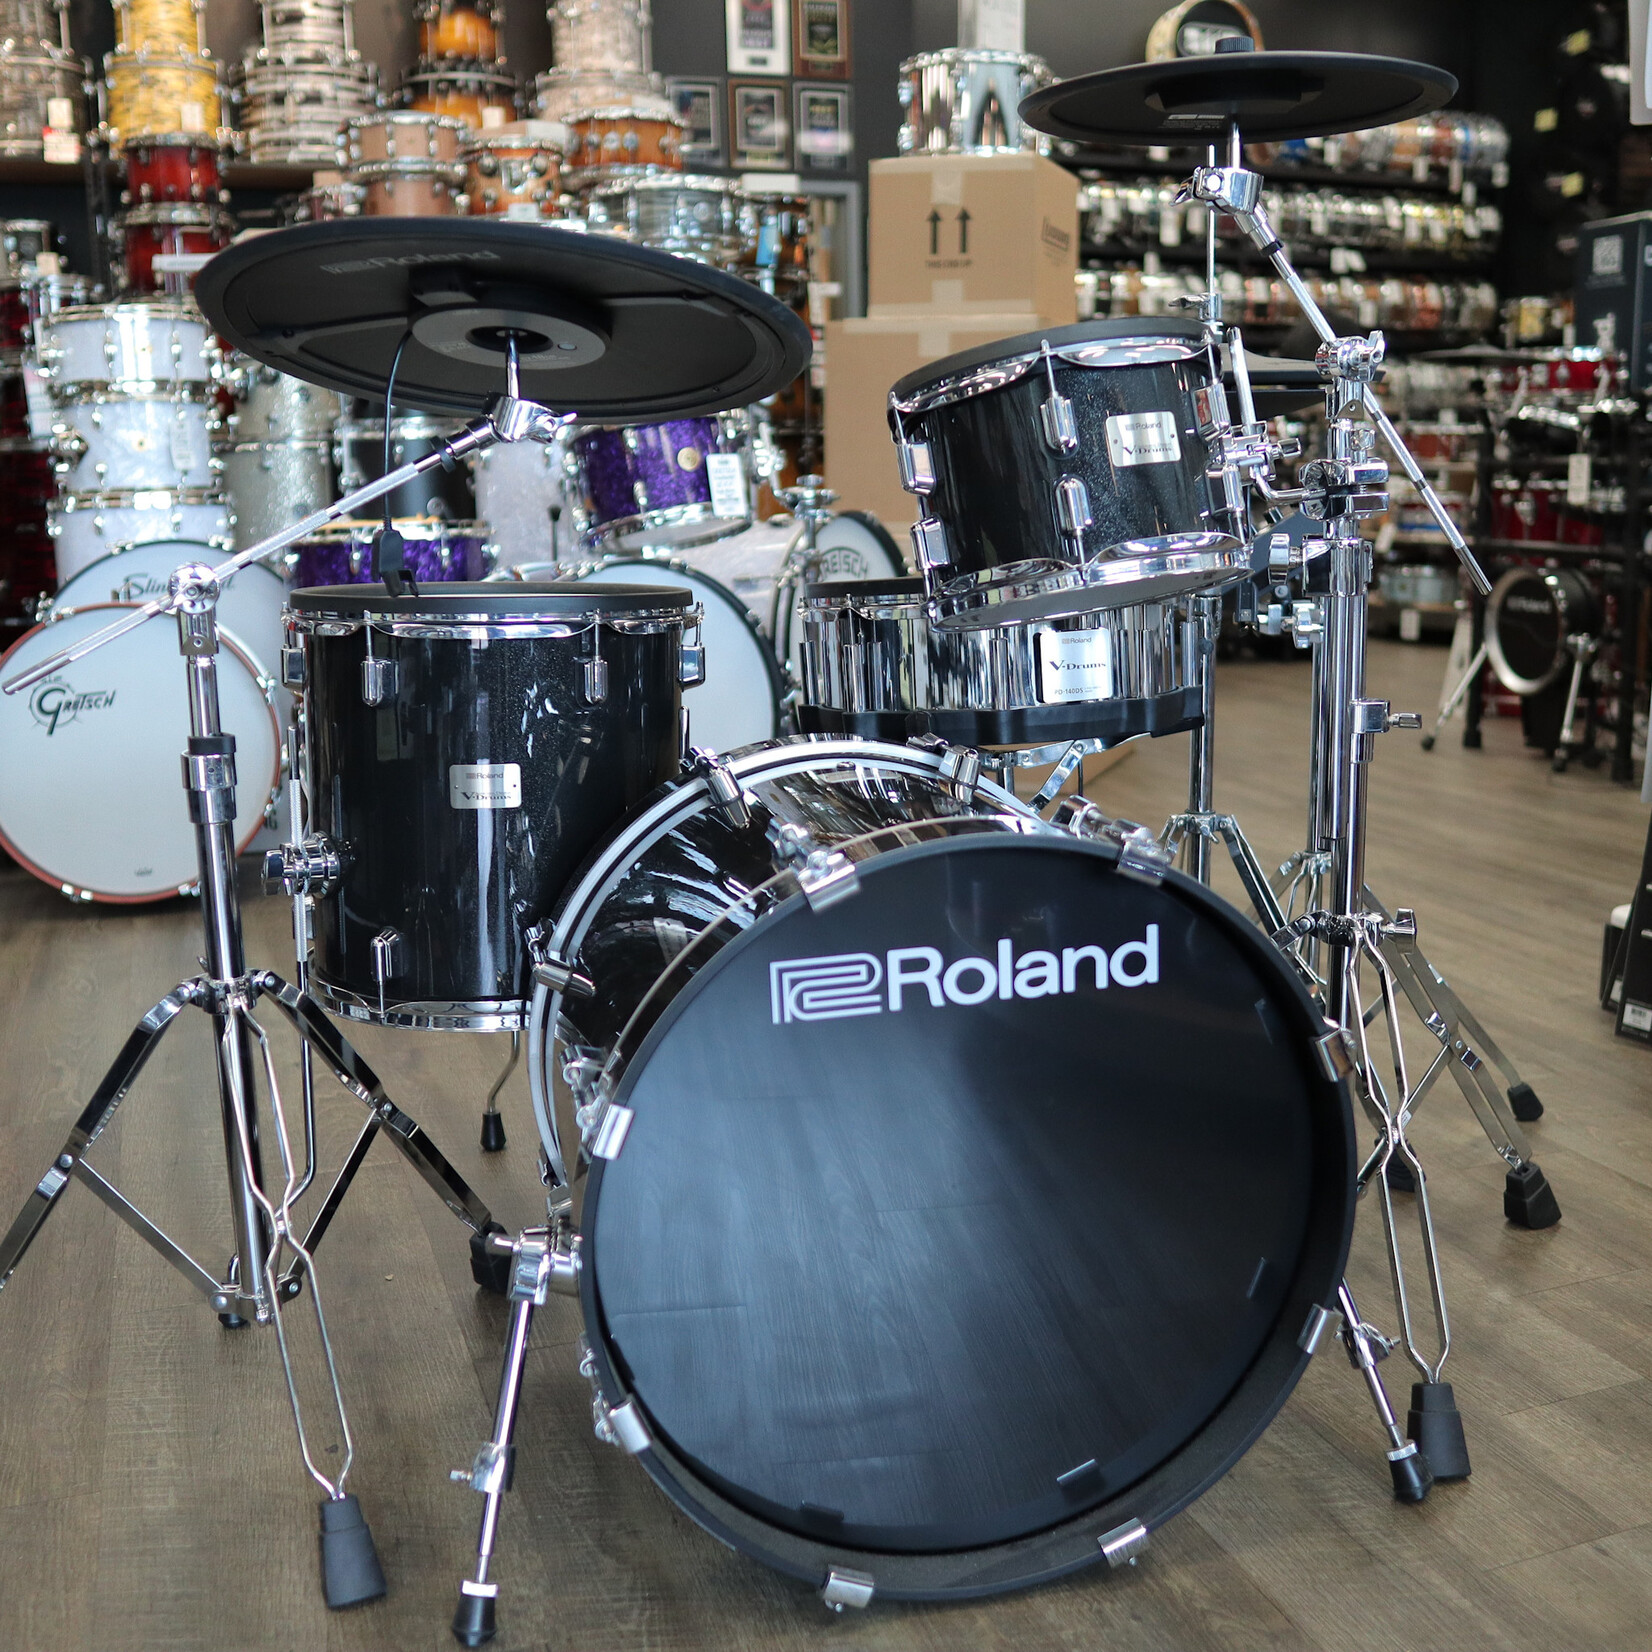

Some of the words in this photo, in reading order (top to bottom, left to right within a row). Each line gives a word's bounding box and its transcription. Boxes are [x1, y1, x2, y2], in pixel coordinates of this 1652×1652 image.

[819, 546, 869, 581] RETSCH
[1049, 660, 1106, 671] V-Drums
[1054, 687, 1084, 696] PD-140DS
[886, 923, 1160, 1012] Roland
